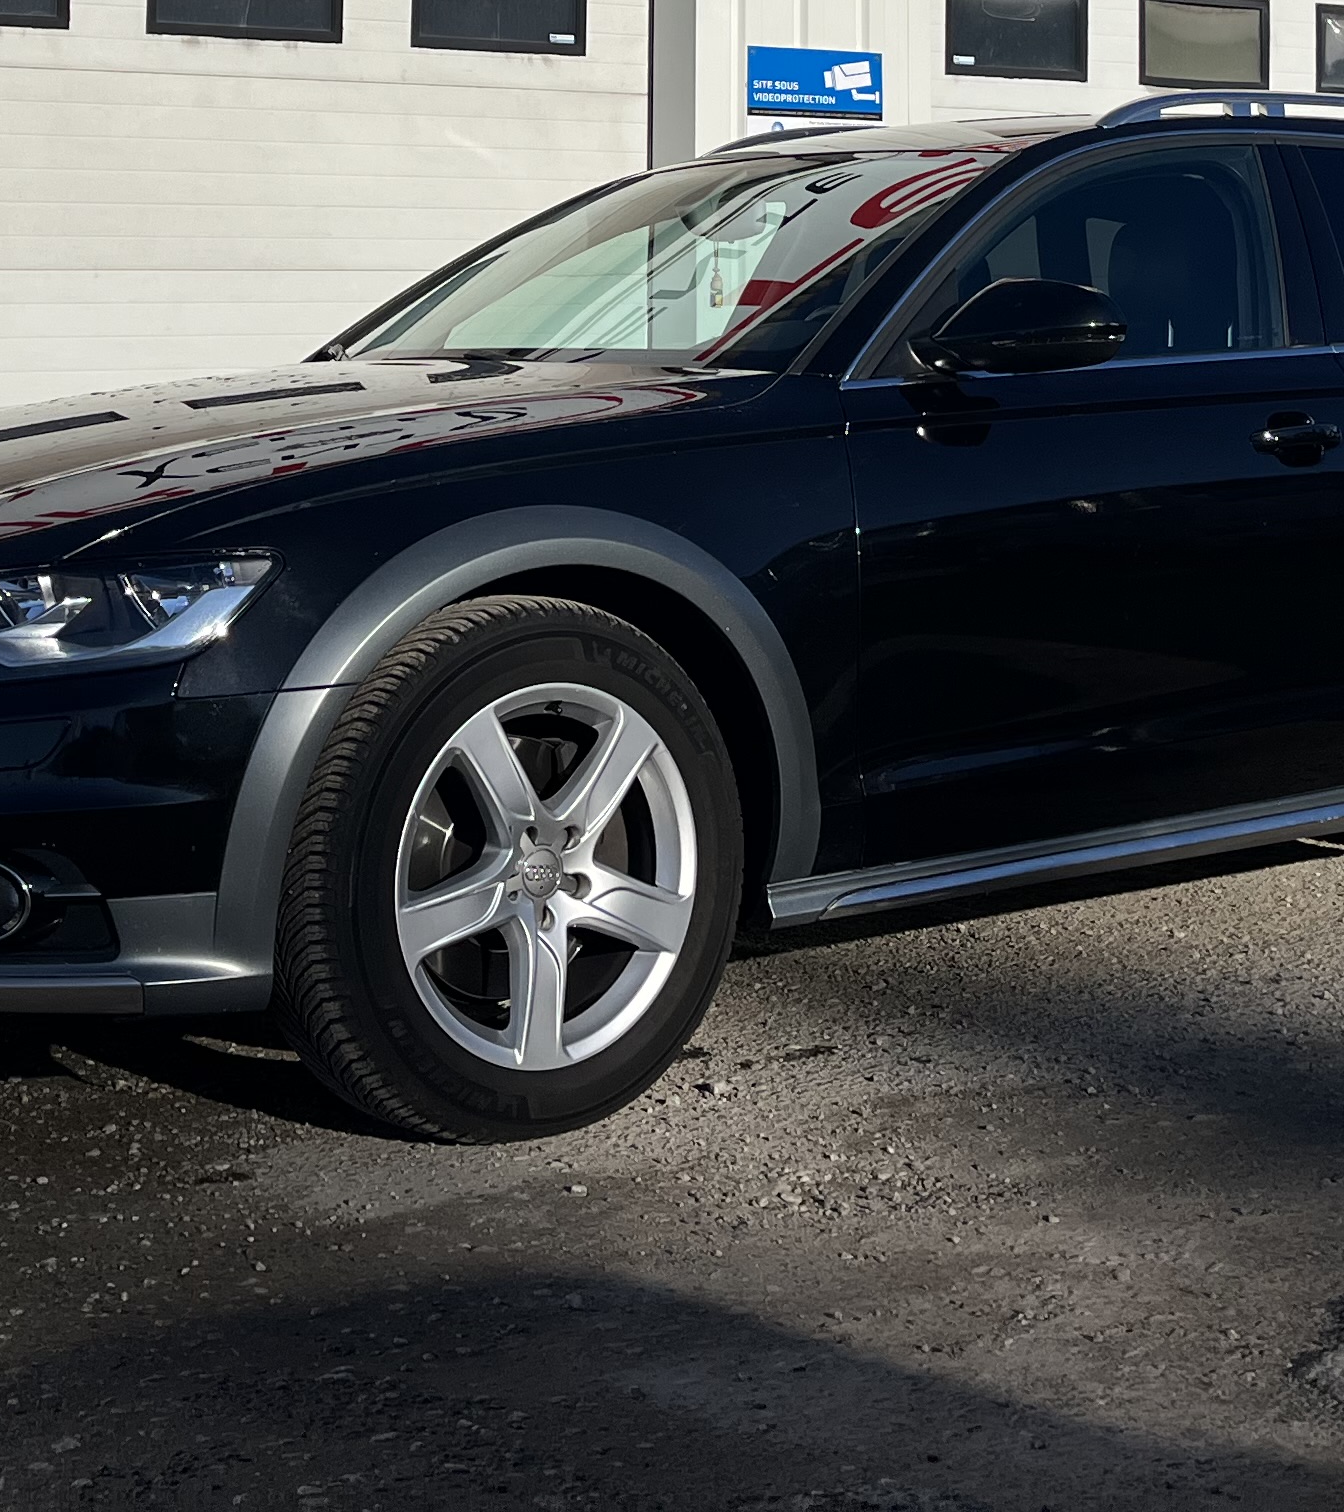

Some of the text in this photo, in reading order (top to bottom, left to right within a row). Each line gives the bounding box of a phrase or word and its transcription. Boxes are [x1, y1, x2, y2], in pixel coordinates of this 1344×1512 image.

[753, 80, 799, 90] SITE SOUS
[753, 92, 836, 104] VIDEOPROTECTION
